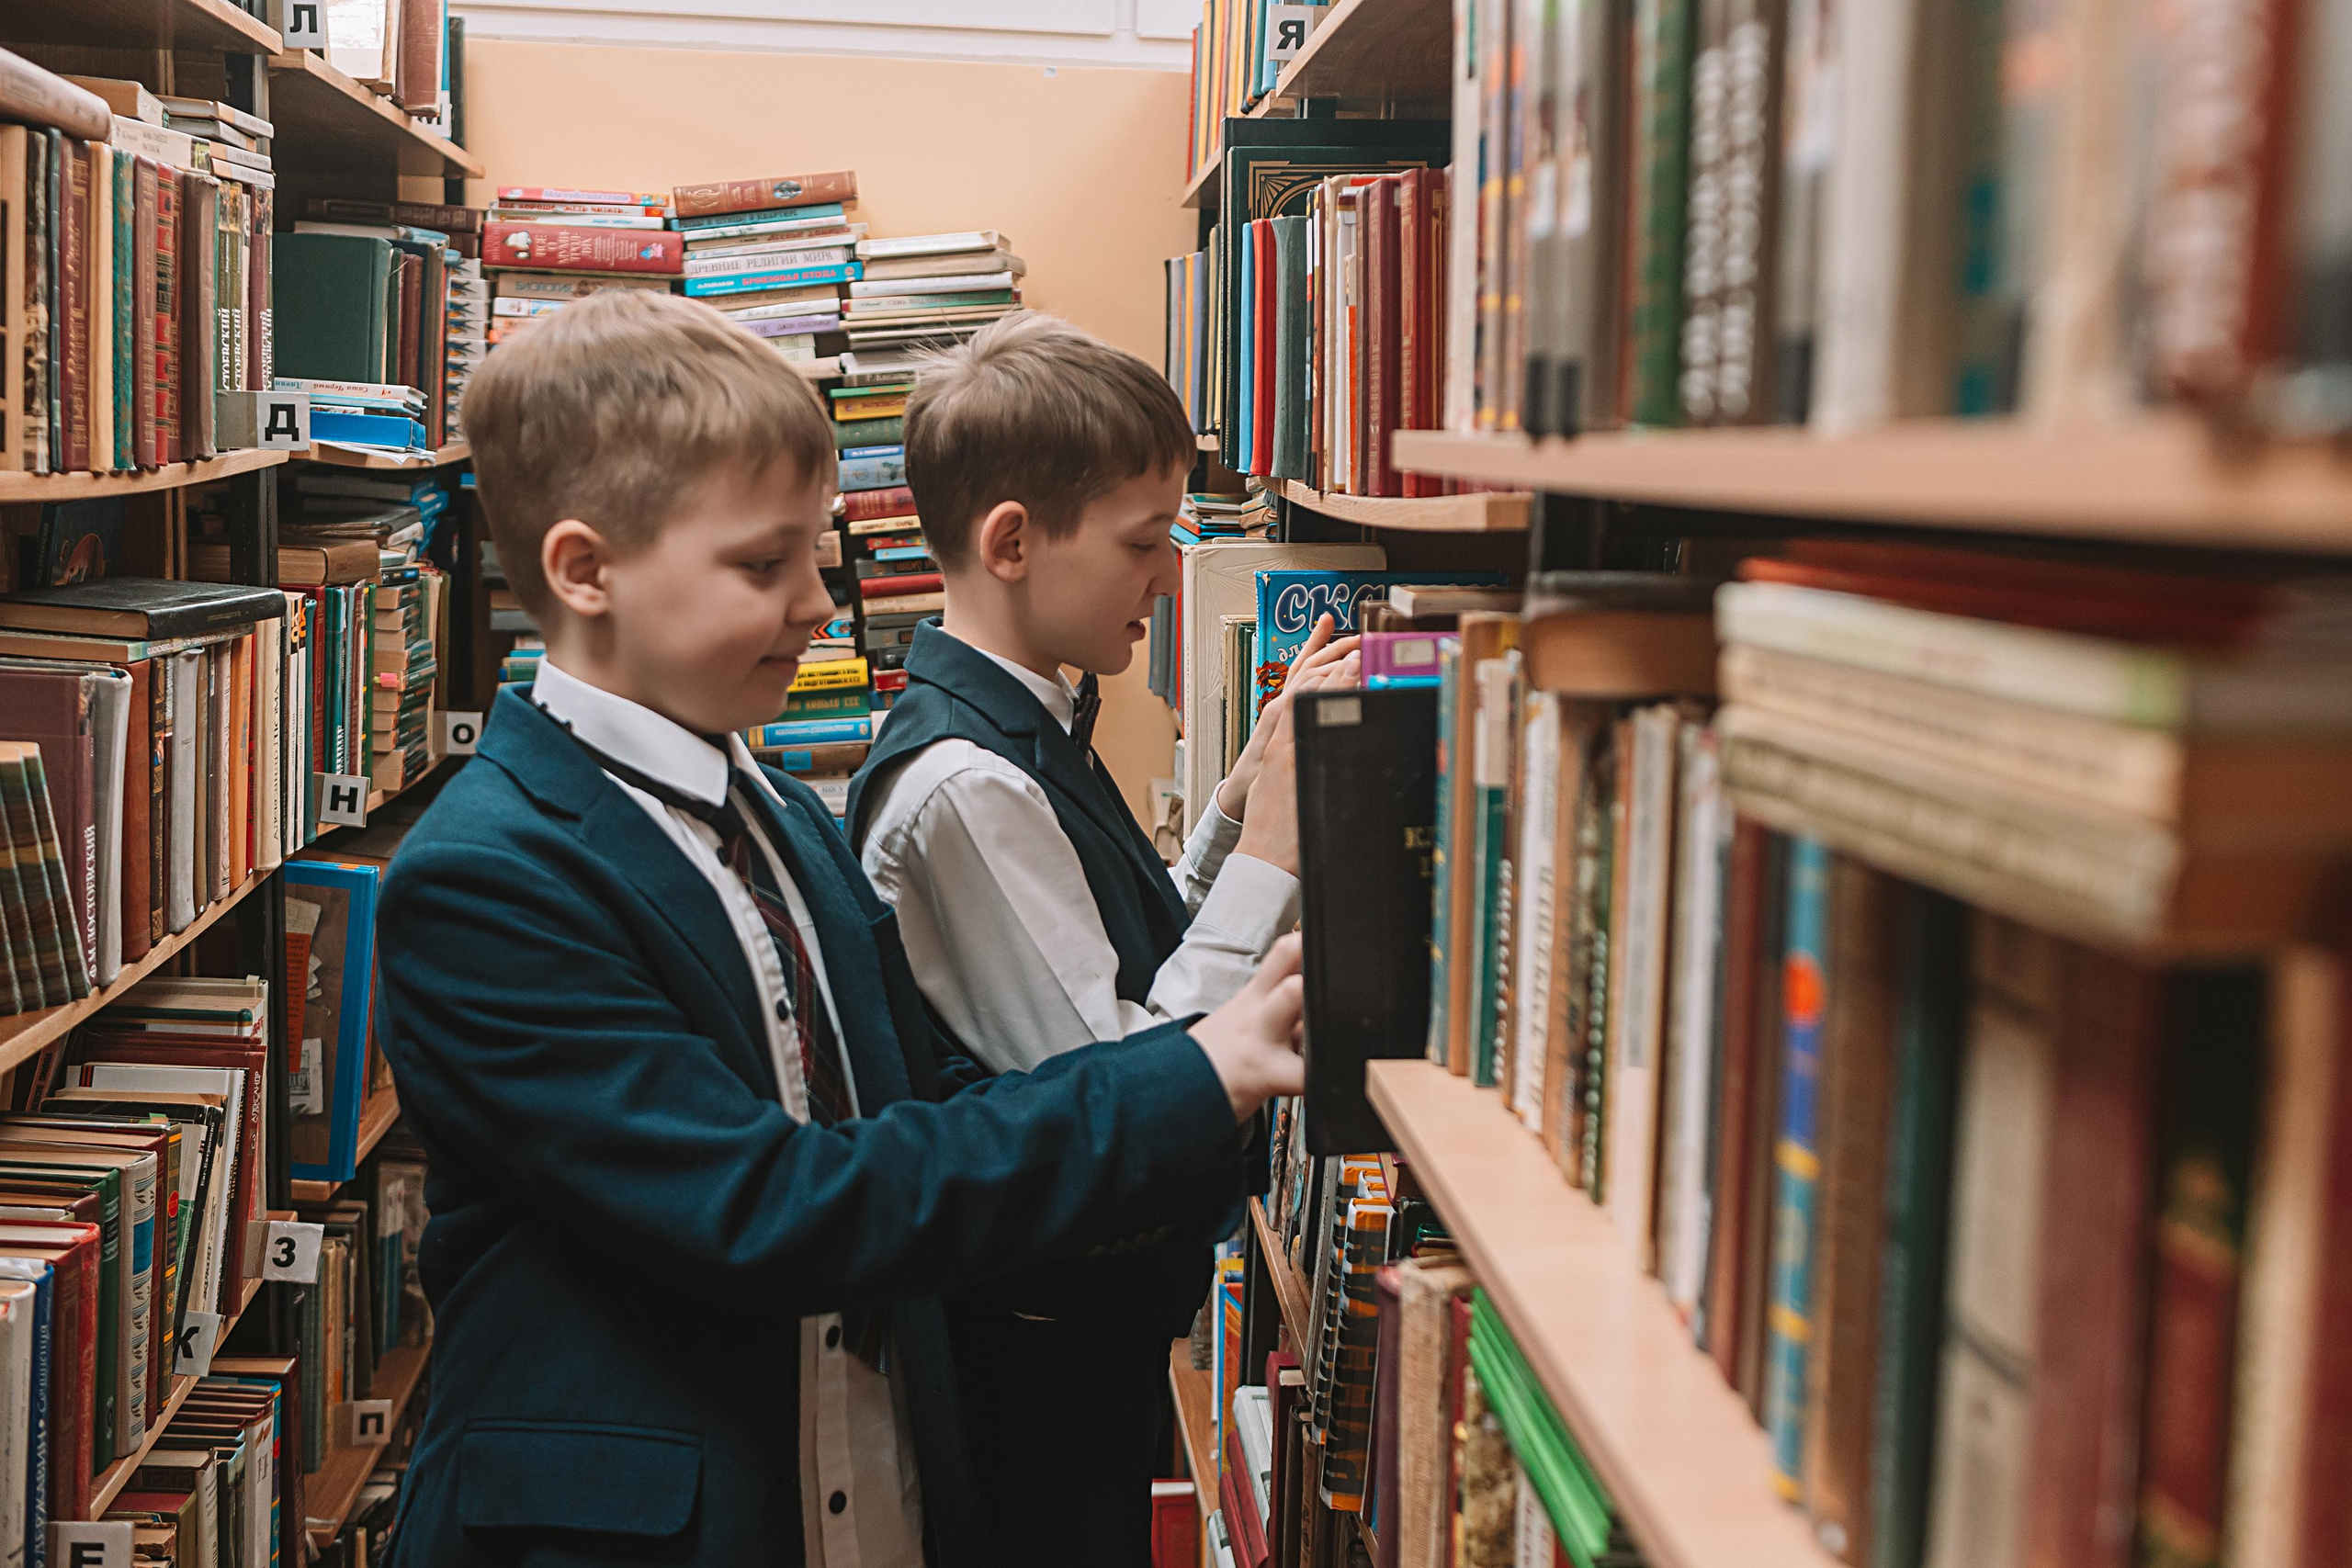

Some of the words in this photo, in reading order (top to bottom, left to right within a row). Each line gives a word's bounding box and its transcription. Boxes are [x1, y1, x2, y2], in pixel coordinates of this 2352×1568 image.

[289, 4, 318, 34] Л
[1276, 19, 1306, 50] Я
[691, 259, 741, 276] ДРЕВНИЕ
[747, 253, 797, 269] РЕЛИГИИ
[803, 249, 834, 264] МИРА
[741, 272, 799, 287] БРОНЗОВАЯ
[802, 268, 837, 279] ПТИЦА
[218, 307, 230, 391] СТОЕВСКИЙ
[313, 382, 344, 391] Черный
[346, 385, 368, 393] Саша
[265, 403, 300, 442] Д
[452, 722, 475, 744] О
[329, 784, 359, 814] Н
[84, 824, 96, 944] ДОСТОЕВСКИЙ
[30, 1084, 44, 1111] SCIEN
[175, 1325, 200, 1359] К
[359, 1412, 383, 1436] П
